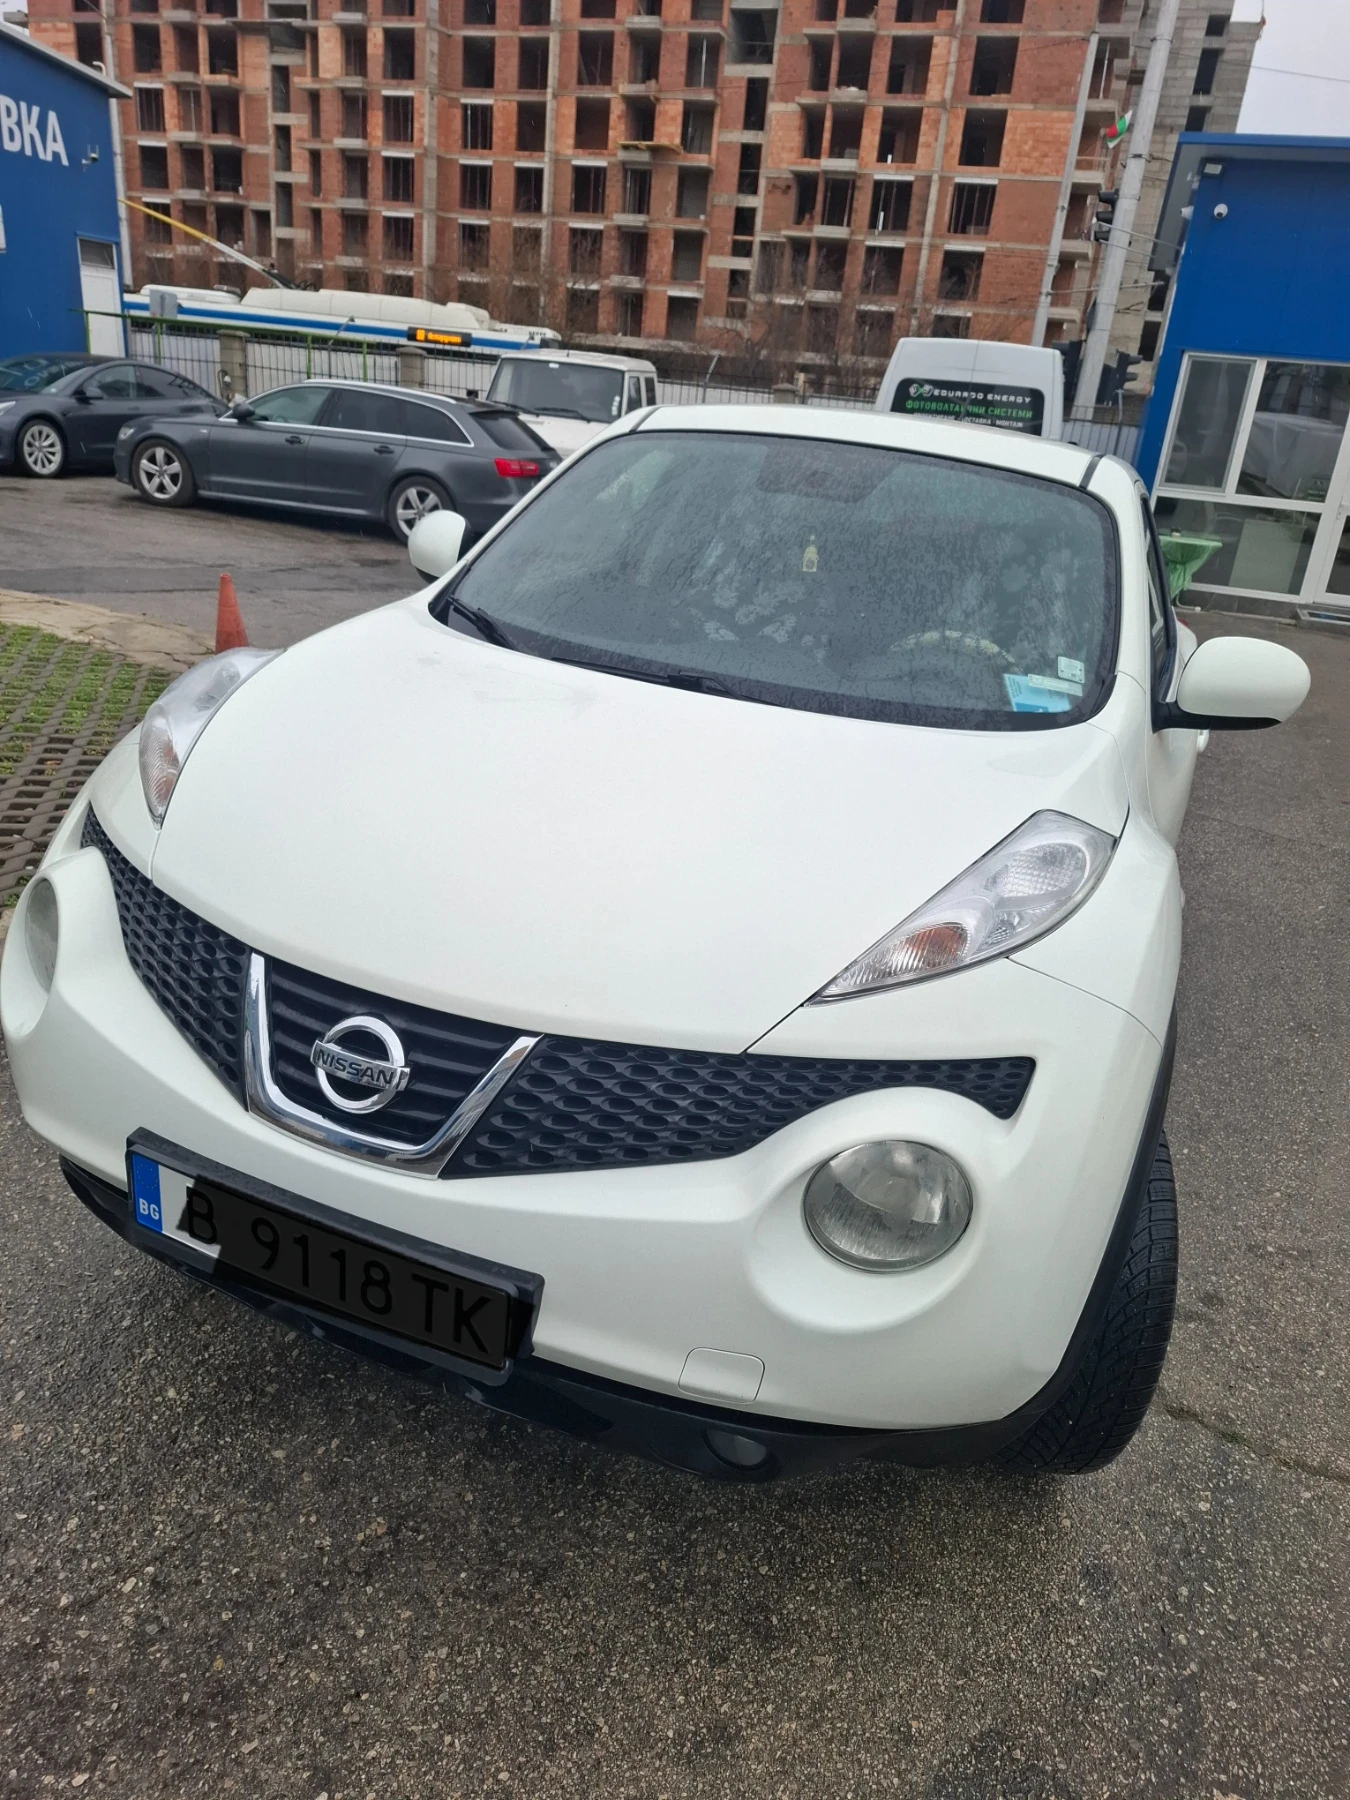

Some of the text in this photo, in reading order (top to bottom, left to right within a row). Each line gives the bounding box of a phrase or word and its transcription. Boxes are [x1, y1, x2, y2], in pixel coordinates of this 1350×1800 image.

[0, 94, 70, 167] ВКА
[934, 389, 1032, 404] EDUARDO ENERGY
[988, 407, 1033, 419] СИСТЕМИ
[316, 1048, 395, 1085] NISSAN
[139, 1198, 160, 1221] BG
[186, 1184, 493, 1354] B 9118 TK
